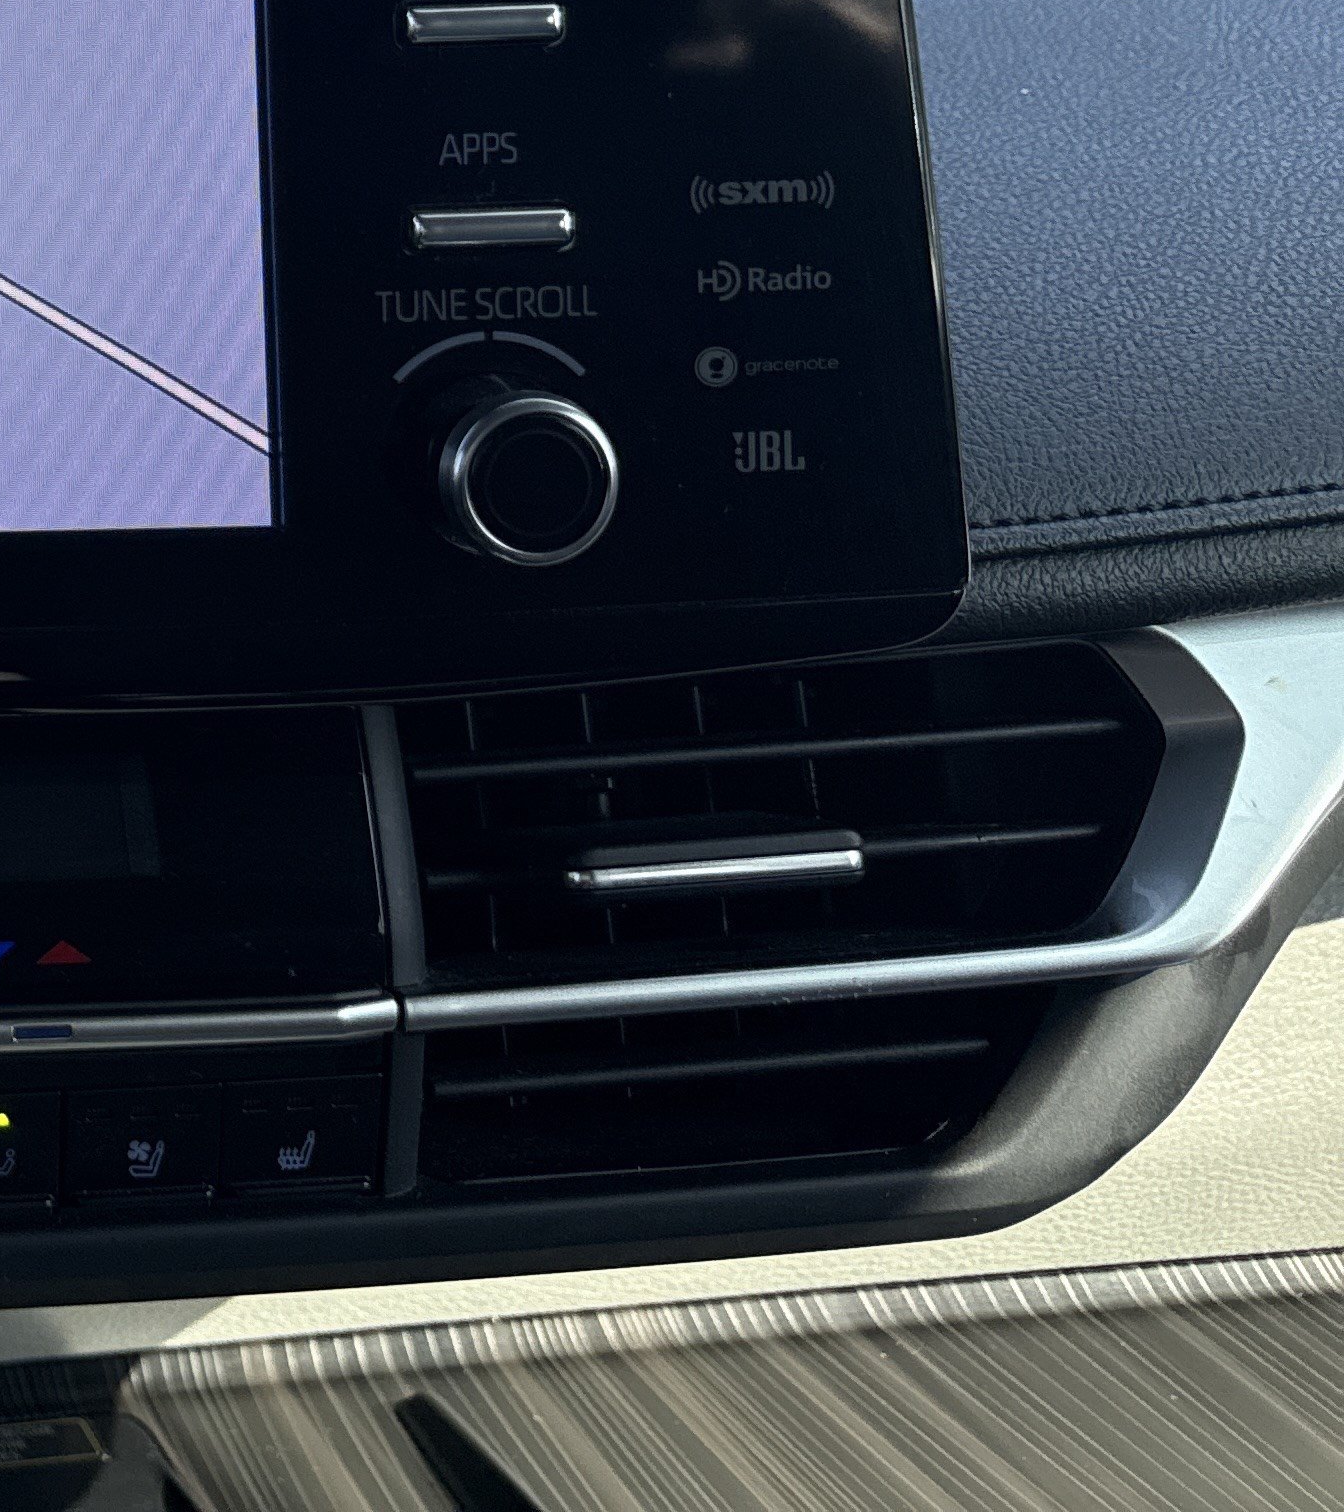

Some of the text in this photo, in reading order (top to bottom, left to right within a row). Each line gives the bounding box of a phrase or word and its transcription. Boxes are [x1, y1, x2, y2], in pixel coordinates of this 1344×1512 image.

[439, 132, 518, 165] APPS
[718, 179, 808, 205] sxm
[747, 265, 832, 292] Radio
[375, 285, 599, 322] TUNE SCROLL
[745, 357, 839, 376] gracenote
[732, 430, 806, 472] JBL
